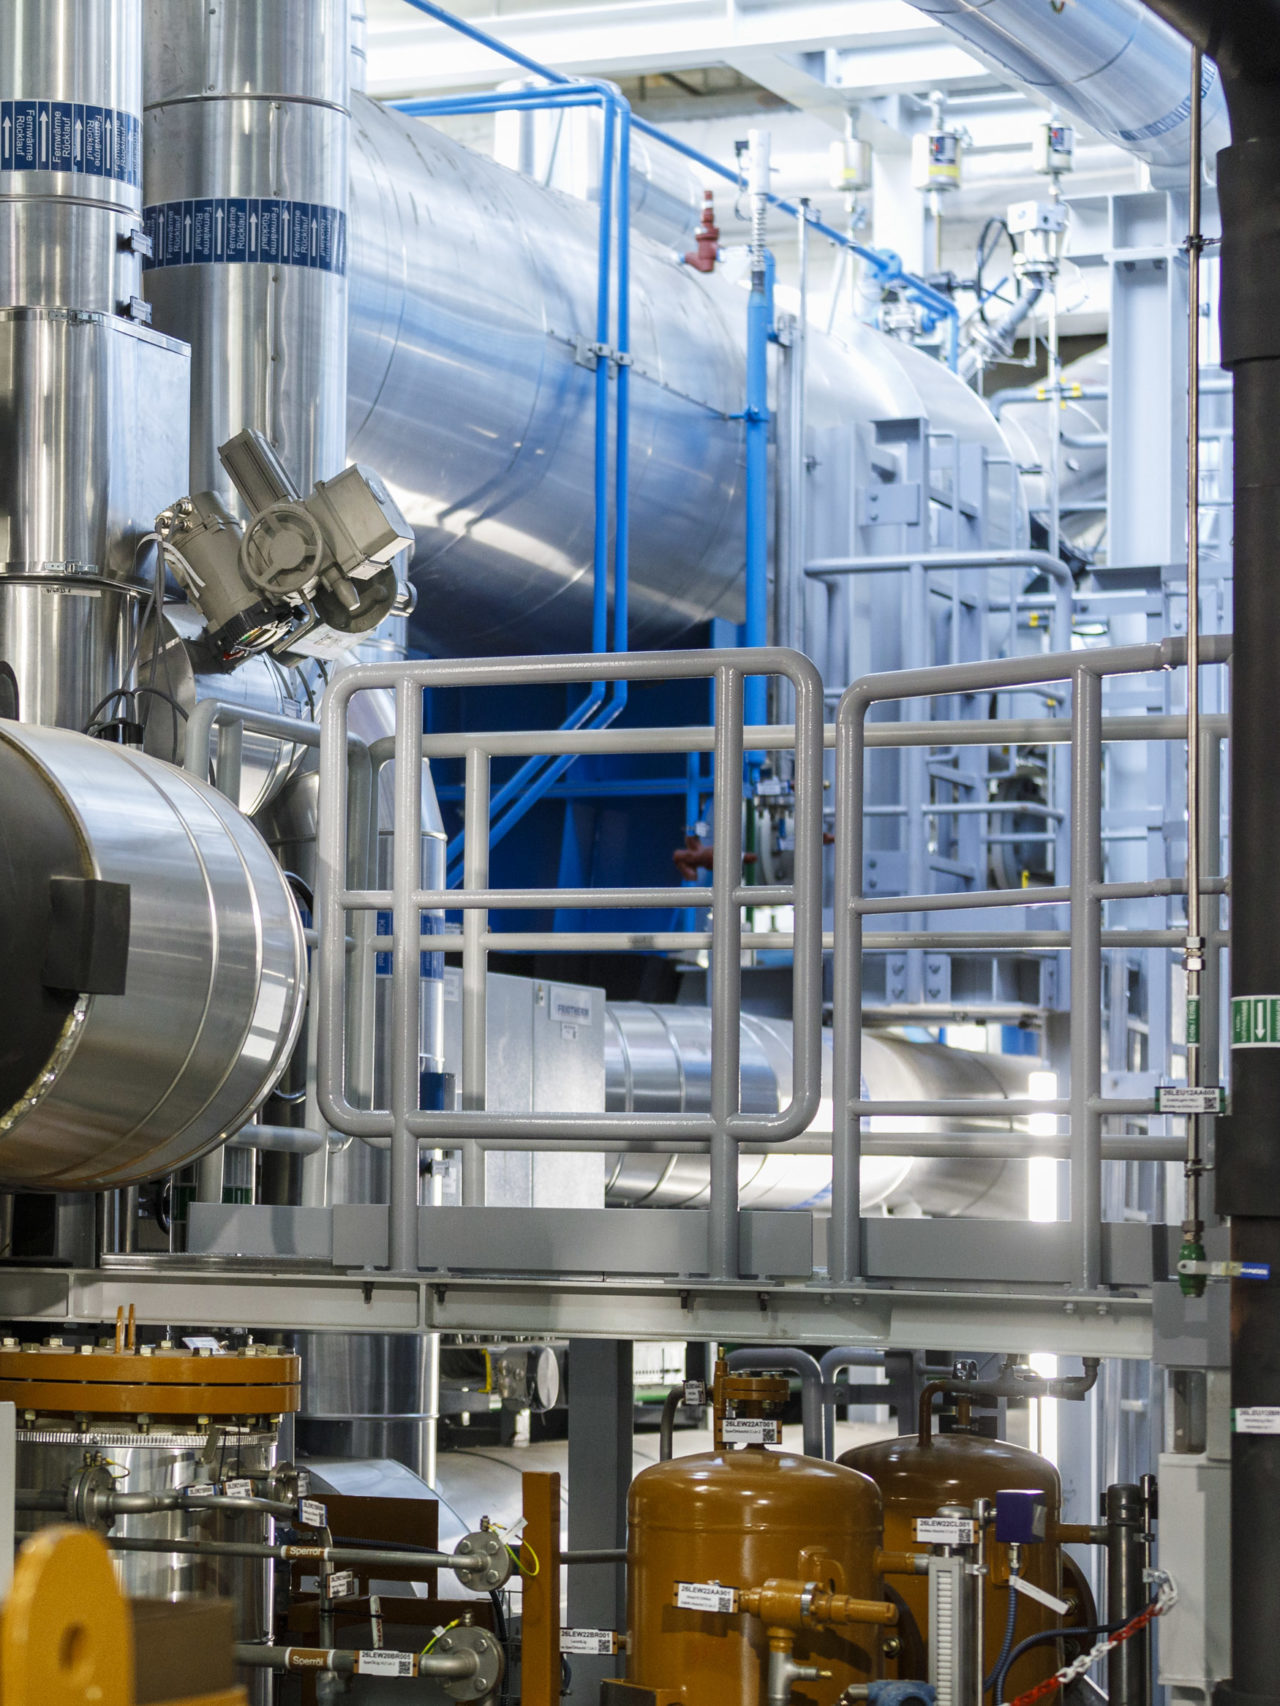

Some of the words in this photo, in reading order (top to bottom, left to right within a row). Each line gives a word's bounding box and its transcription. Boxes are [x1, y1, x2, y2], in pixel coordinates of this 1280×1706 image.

[16, 115, 25, 156] Rücklauf
[26, 109, 35, 161] Fernwärme
[53, 110, 62, 163] Fernwärme
[62, 117, 71, 158] Rücklauf
[86, 119, 94, 161] Rücklauf
[95, 115, 103, 167] Fernwärme
[195, 213, 203, 250] Rücklauf
[203, 207, 212, 255] Fernwärme
[227, 206, 237, 255] Fernwärme
[237, 212, 245, 249] Rücklauf
[261, 212, 270, 250] Rücklauf
[270, 207, 279, 255] Fernwärme
[293, 209, 301, 257] Fernwärme
[301, 215, 309, 253] Rücklauf
[292, 1655, 324, 1666] Sperröl
